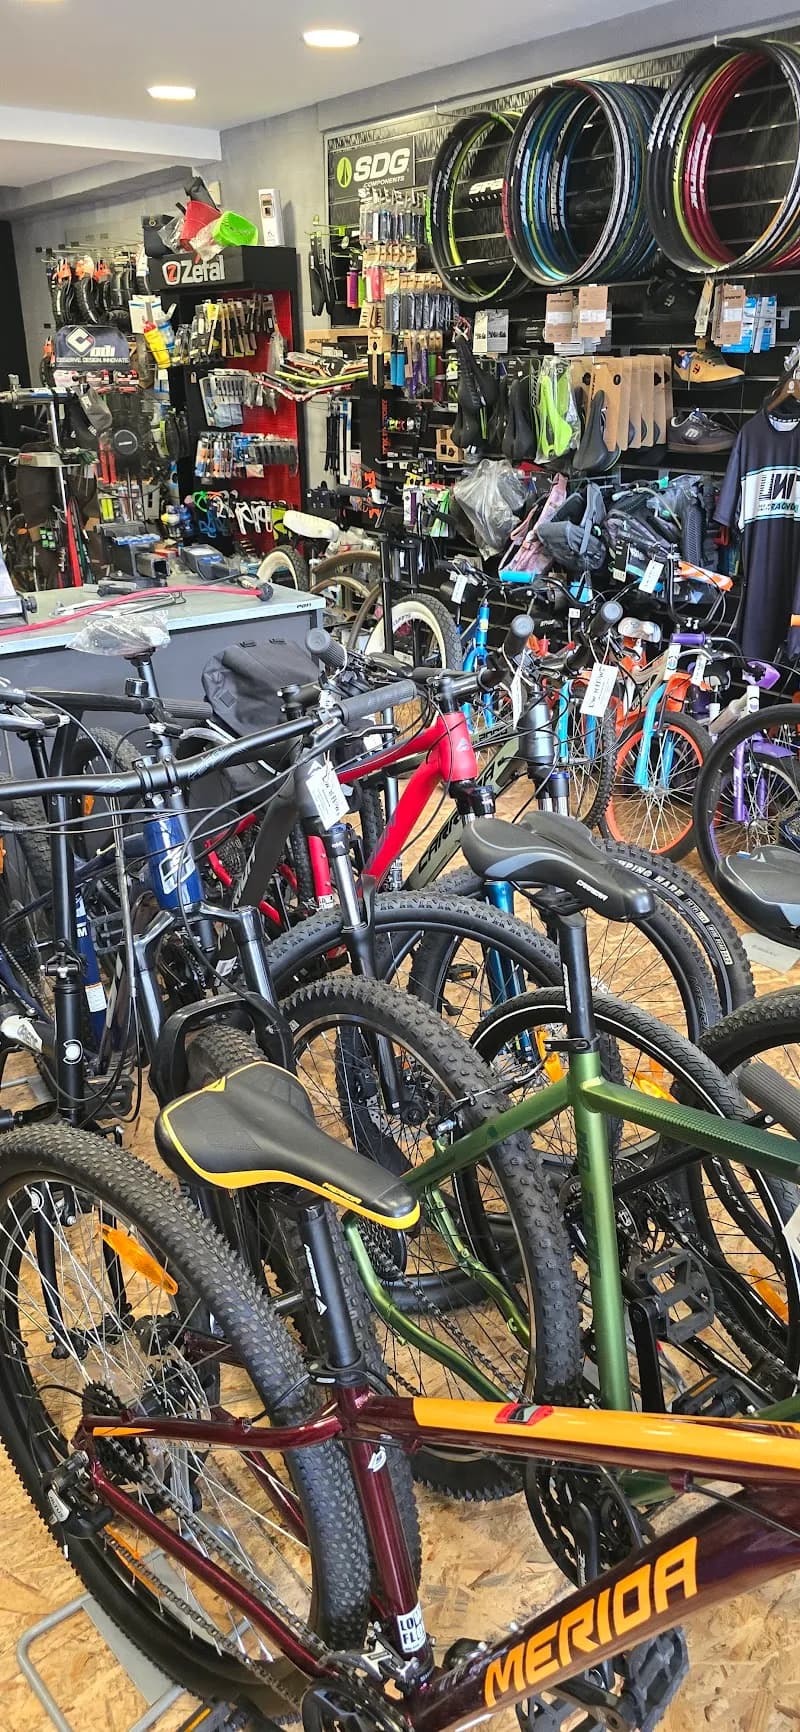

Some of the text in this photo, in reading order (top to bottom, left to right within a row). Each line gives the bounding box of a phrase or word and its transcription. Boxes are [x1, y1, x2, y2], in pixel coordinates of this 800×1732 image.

[353, 147, 410, 182] SDG
[363, 175, 405, 188] COMPONENTS
[653, 875, 686, 897] HARE
[484, 1536, 698, 1708] MERIDA
